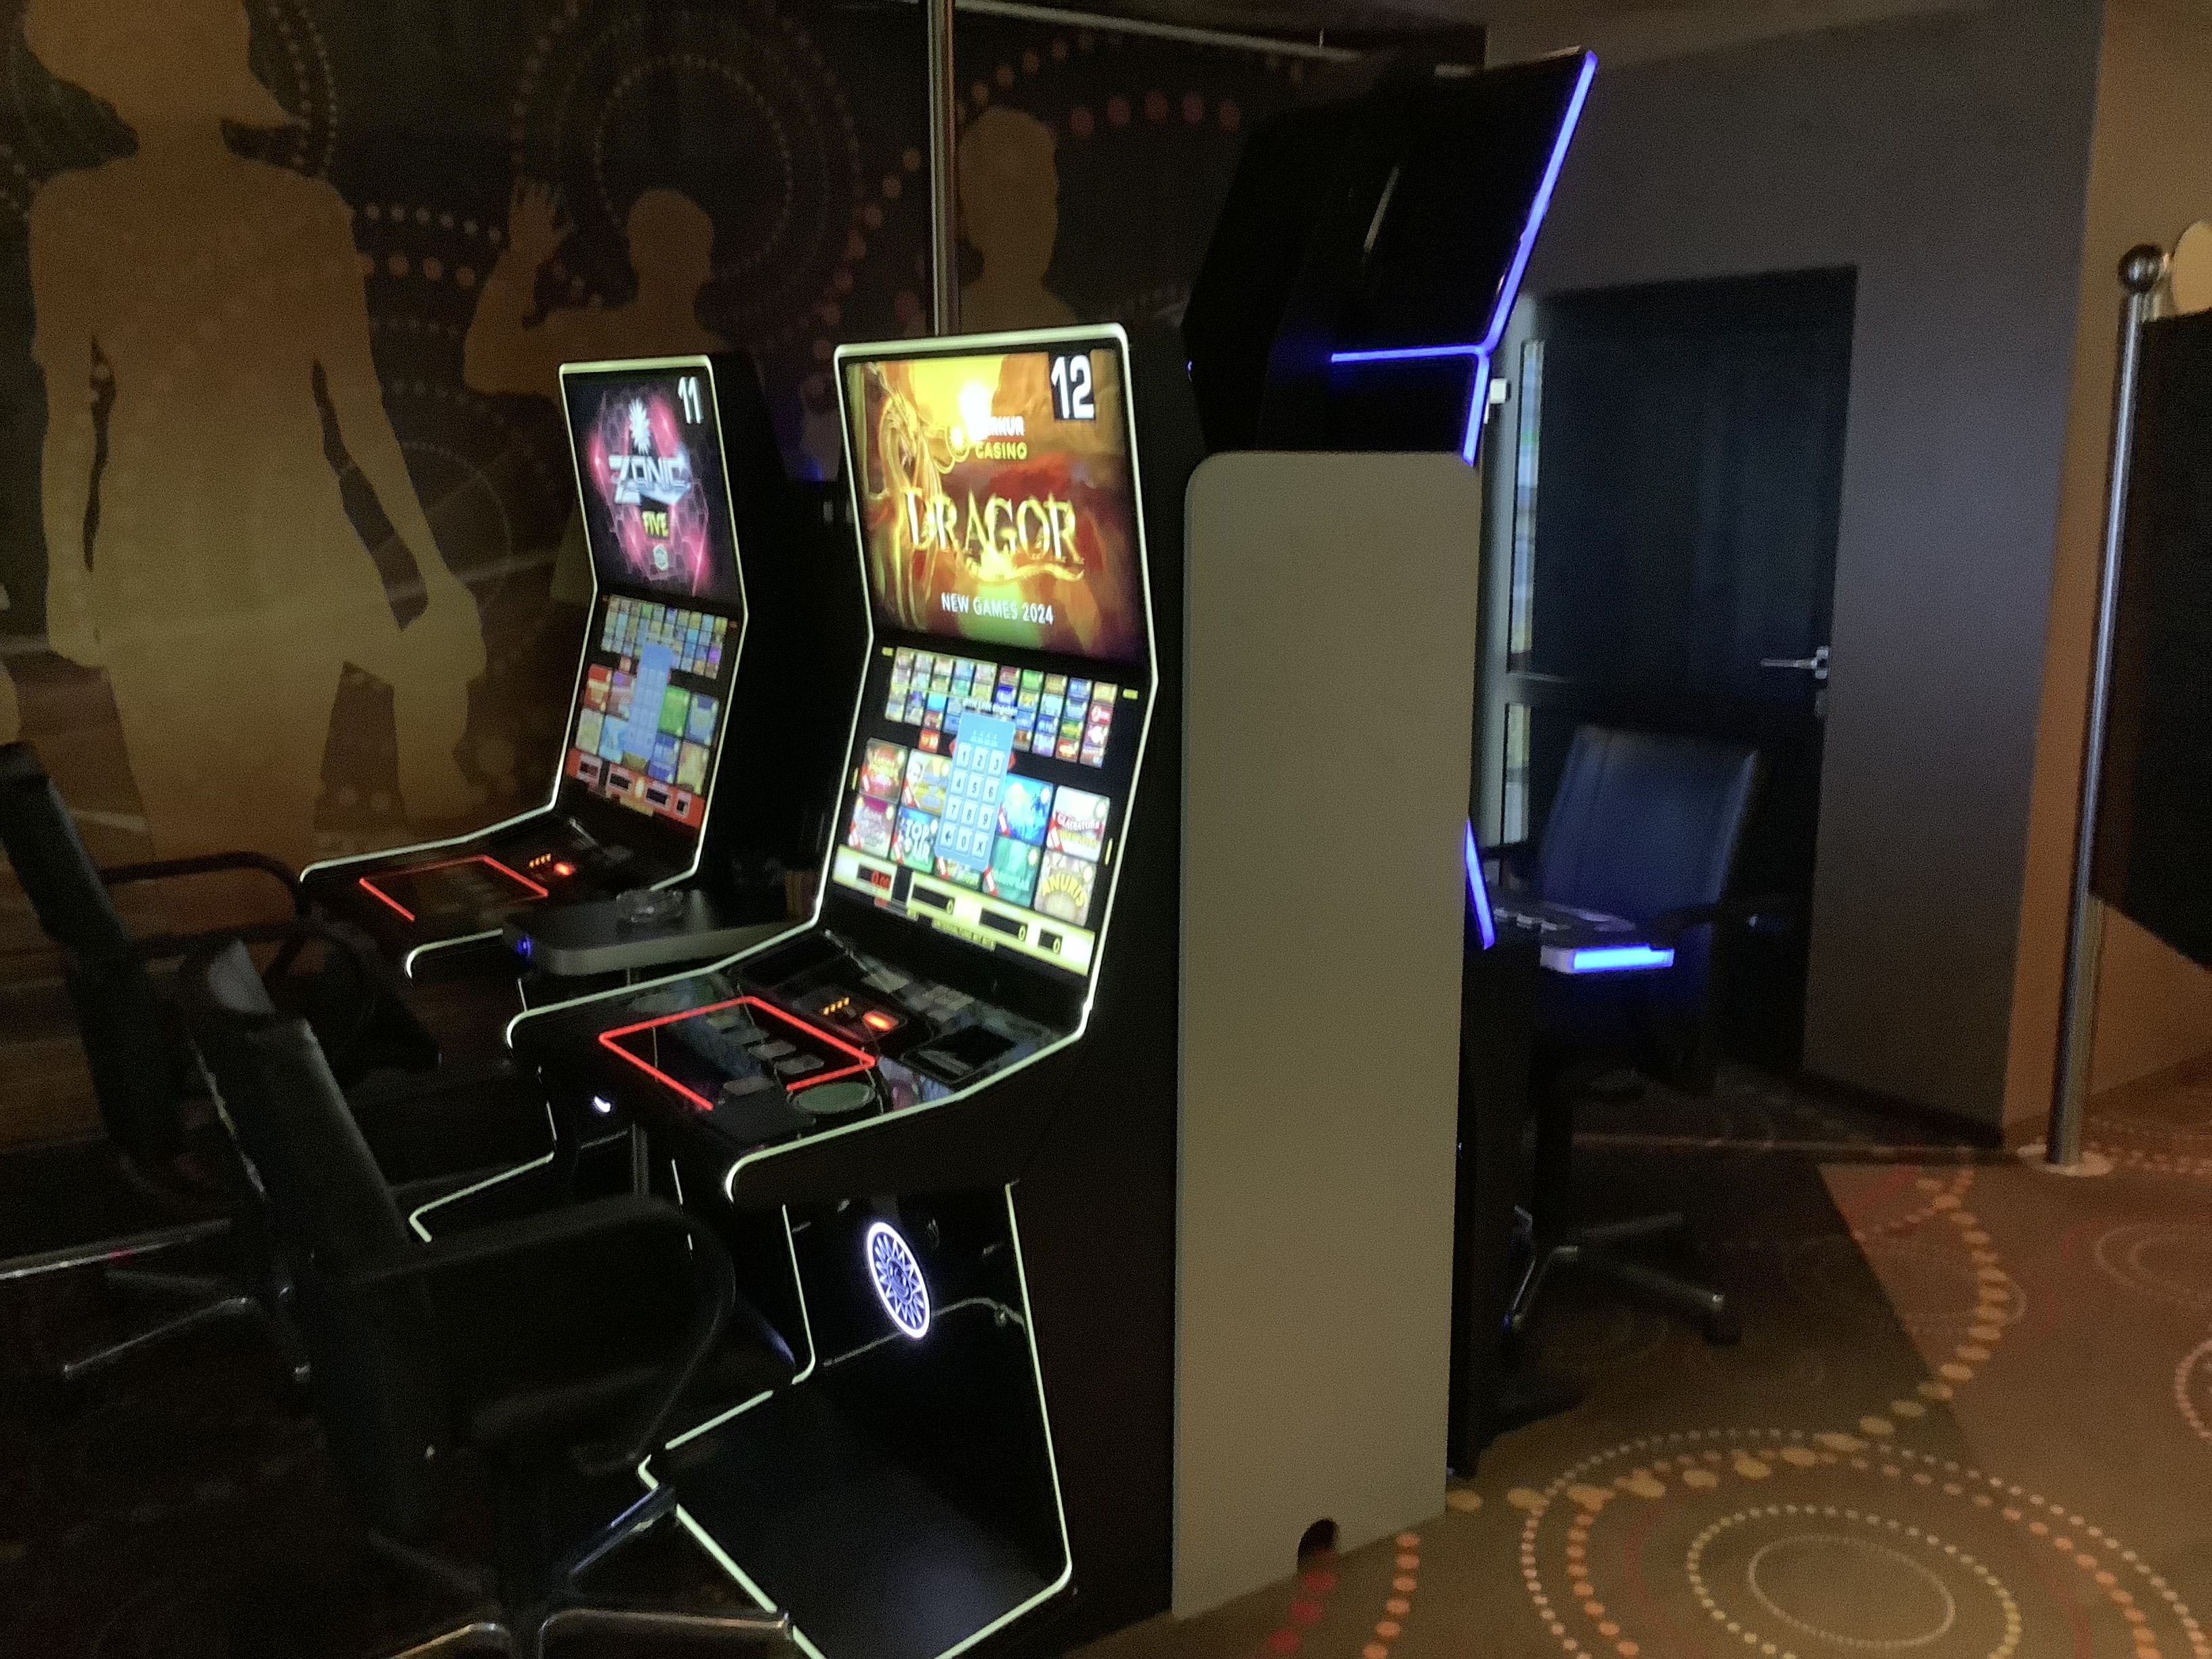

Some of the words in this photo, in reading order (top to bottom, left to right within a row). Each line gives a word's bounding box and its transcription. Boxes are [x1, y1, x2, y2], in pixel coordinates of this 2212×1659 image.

[1051, 354, 1096, 419] 12
[678, 377, 702, 424] 11
[975, 441, 1028, 460] CASINO
[642, 511, 669, 538] FIVE
[941, 592, 969, 614] NEW
[972, 596, 1018, 620] GAMES
[1022, 602, 1054, 626] 2024
[962, 750, 966, 762] 1
[977, 755, 983, 766] 2
[993, 759, 999, 771] 3
[956, 778, 962, 789] 4
[972, 782, 977, 794] 5
[988, 786, 994, 798] 6
[951, 804, 956, 815] 7
[966, 809, 972, 821] 8
[983, 814, 989, 825] 9
[905, 819, 930, 840] TOP
[961, 836, 967, 848] 0
[1042, 872, 1088, 907] ANURIS
[946, 899, 953, 913] 0
[1019, 923, 1026, 940] 0
[1053, 938, 1061, 954] 0
